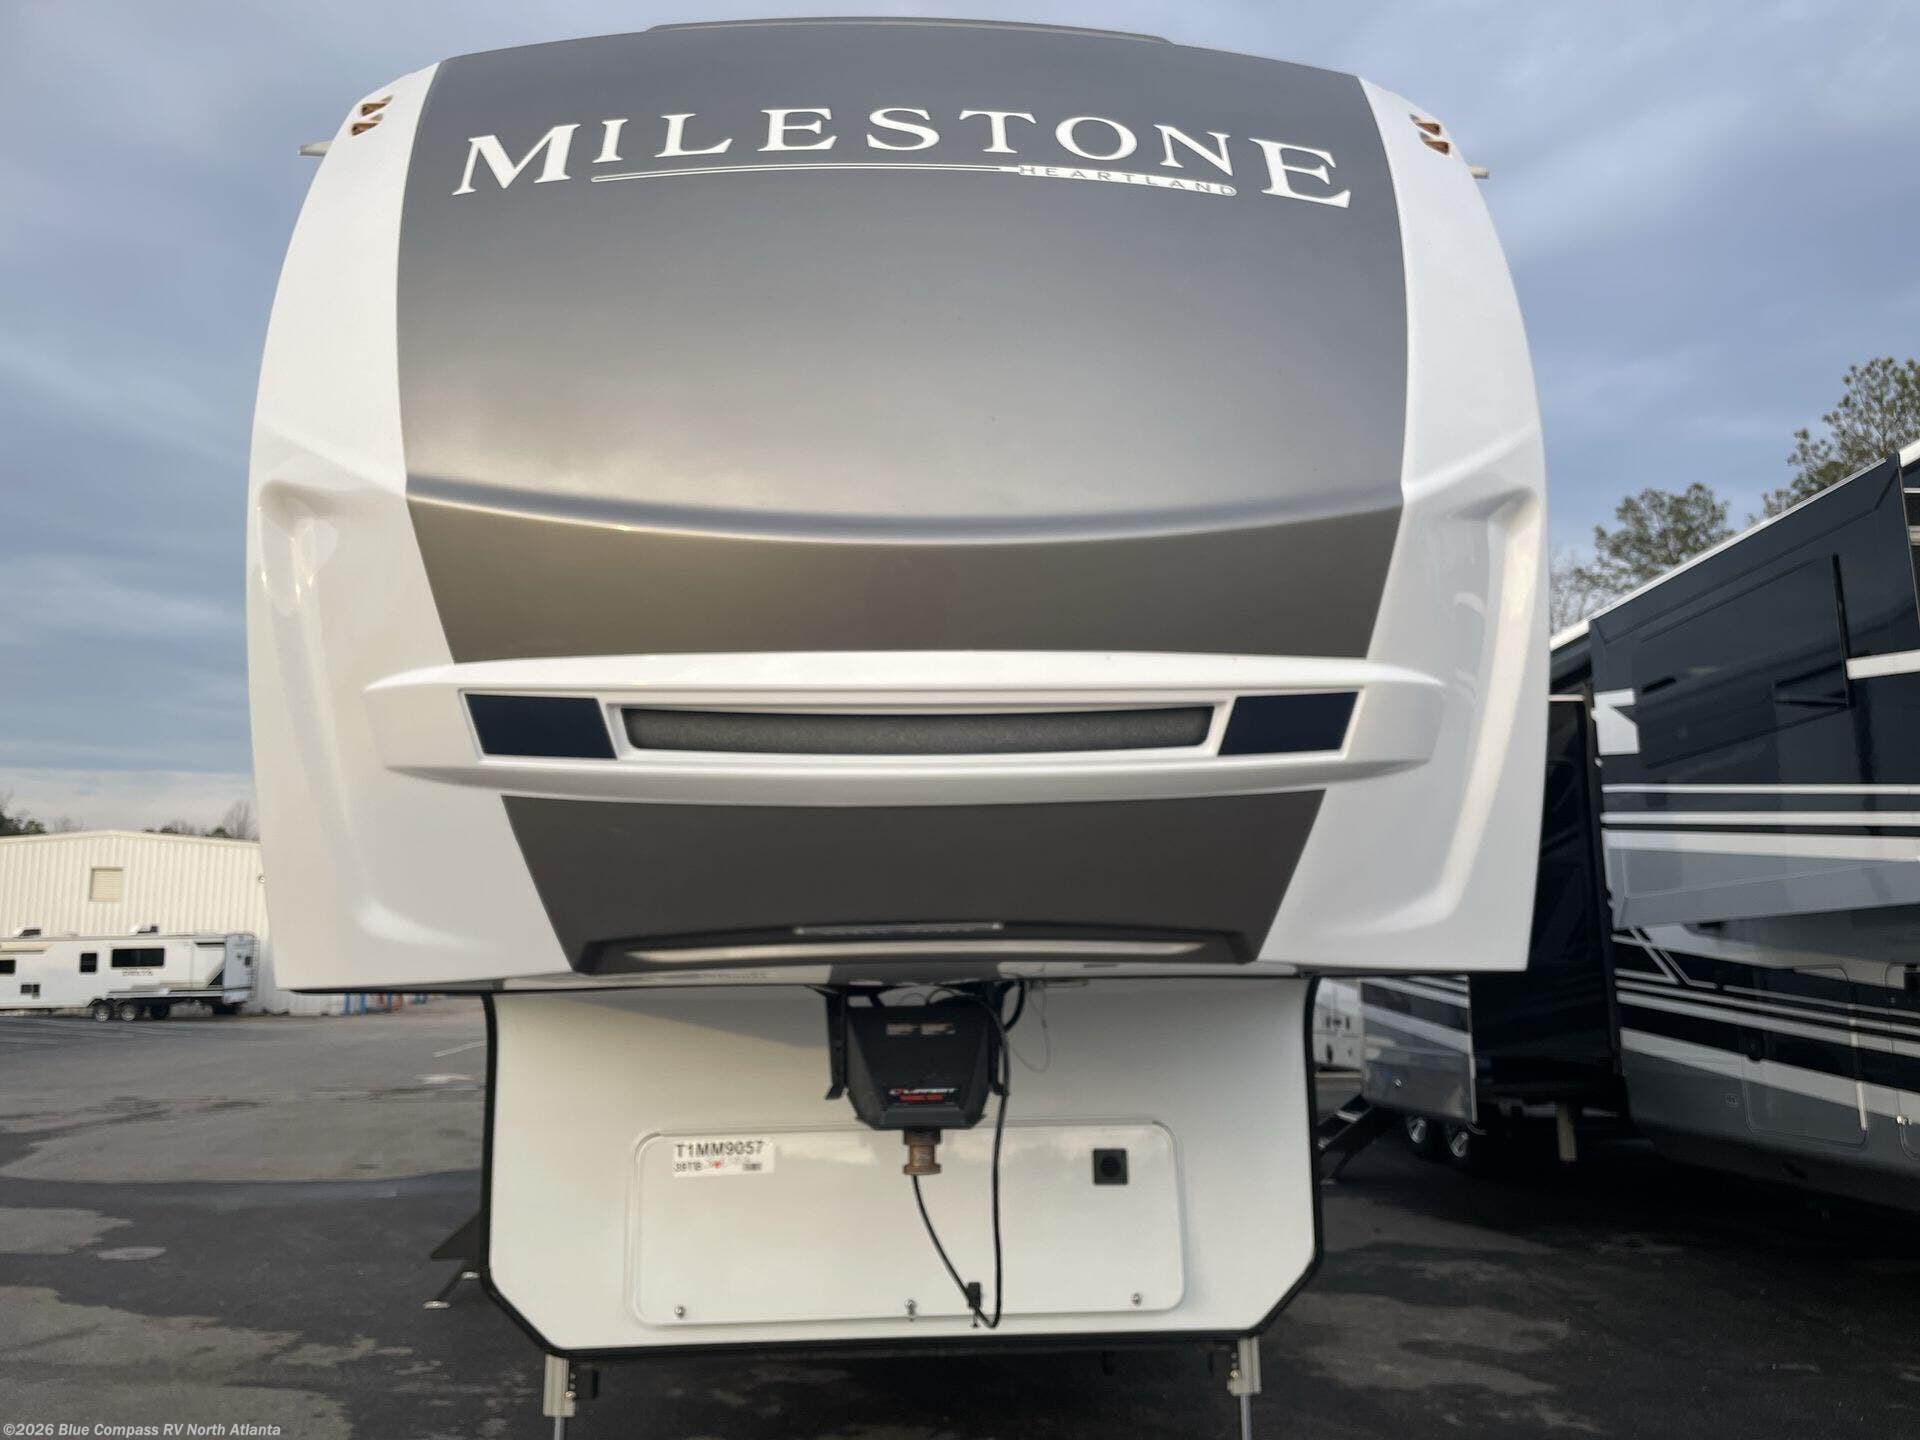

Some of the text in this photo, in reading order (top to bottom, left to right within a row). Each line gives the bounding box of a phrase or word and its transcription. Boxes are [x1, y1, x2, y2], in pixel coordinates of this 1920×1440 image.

[451, 107, 1352, 208] MILESTONE
[1020, 165, 1236, 195] HEARTLAND
[676, 1140, 763, 1158] T1MM9057
